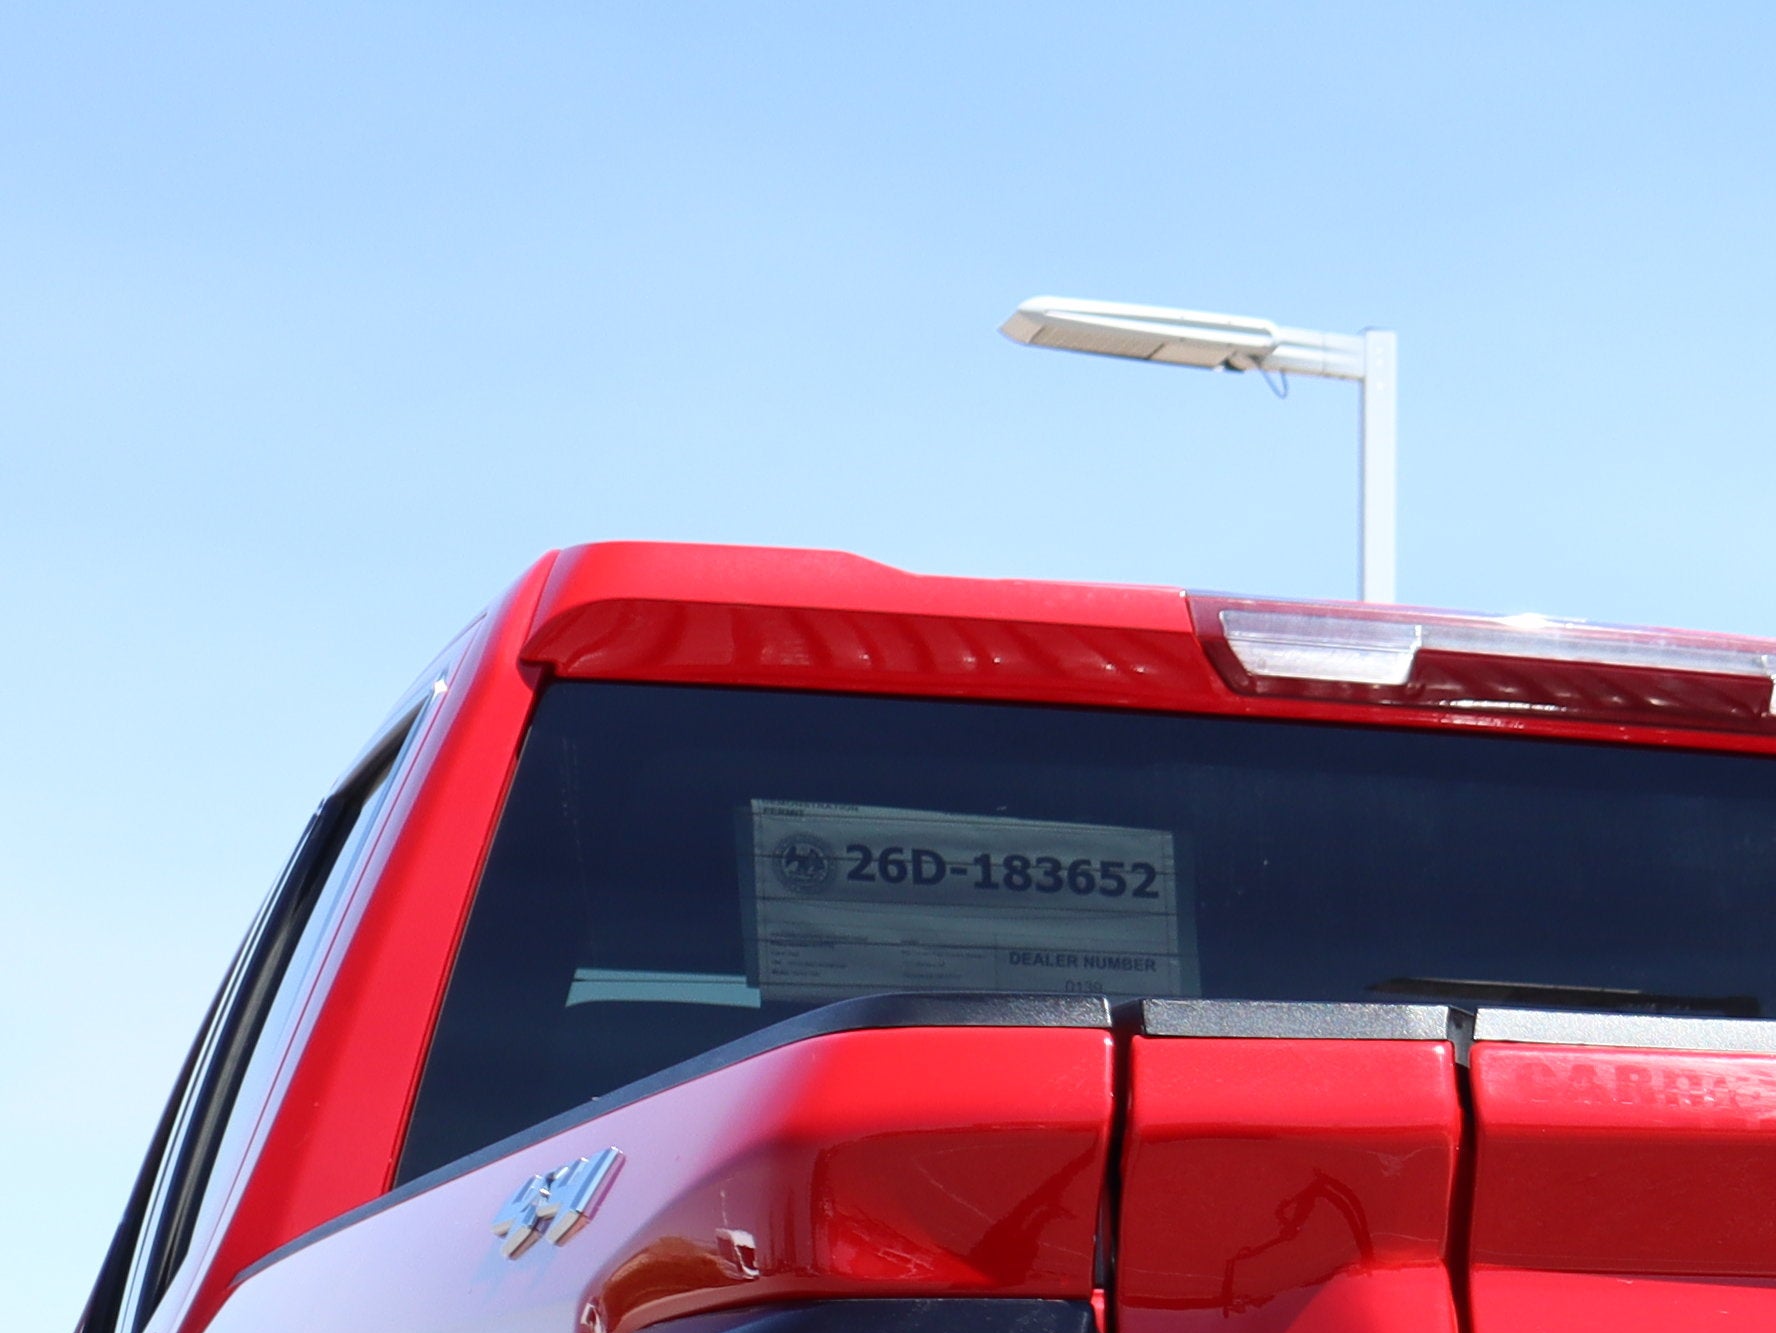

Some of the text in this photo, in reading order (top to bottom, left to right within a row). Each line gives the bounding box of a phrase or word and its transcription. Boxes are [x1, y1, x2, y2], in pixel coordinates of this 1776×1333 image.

[846, 844, 1159, 899] 26D-183652
[1009, 951, 1157, 973] DEALER NUMBER
